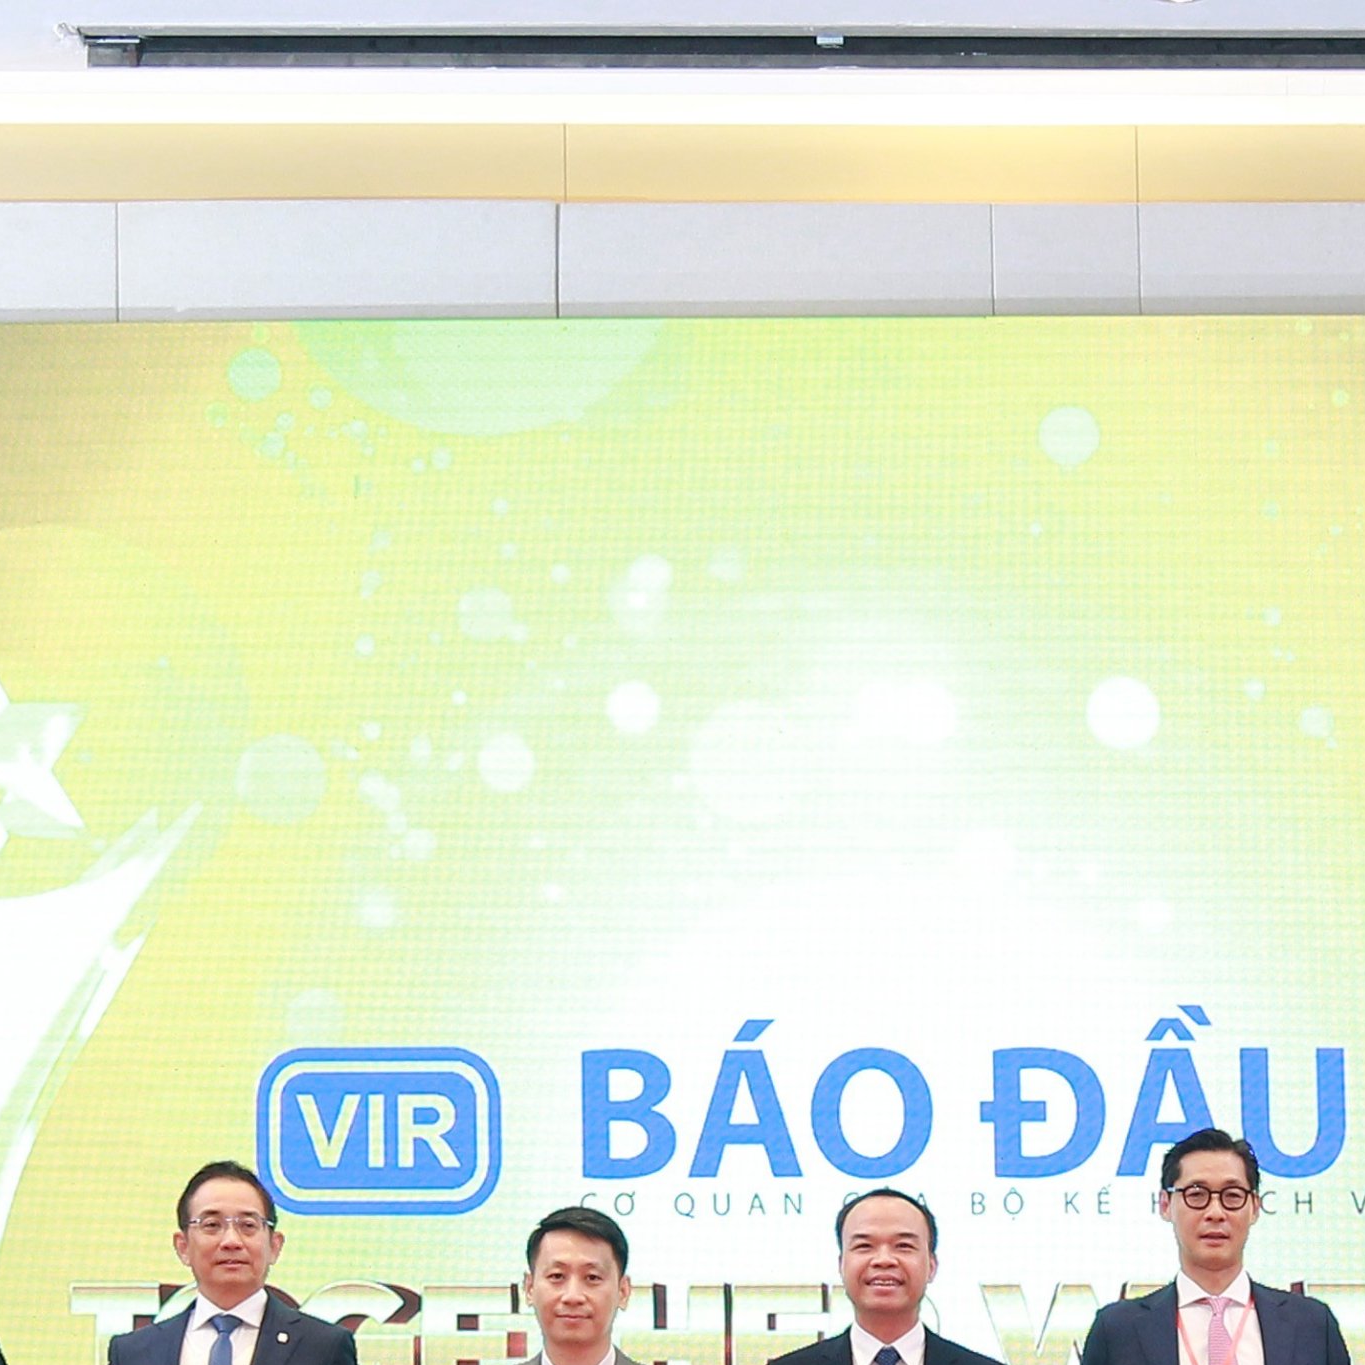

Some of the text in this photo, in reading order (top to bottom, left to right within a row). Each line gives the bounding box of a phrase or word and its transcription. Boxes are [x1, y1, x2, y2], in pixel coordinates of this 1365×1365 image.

[581, 1018, 933, 1180] BÁO
[979, 1005, 1347, 1180] ĐẦU
[295, 1093, 462, 1169] VIR
[674, 1192, 802, 1218] QUAN
[971, 1187, 1024, 1221] BỘ
[1065, 1184, 1111, 1215] KẾ
